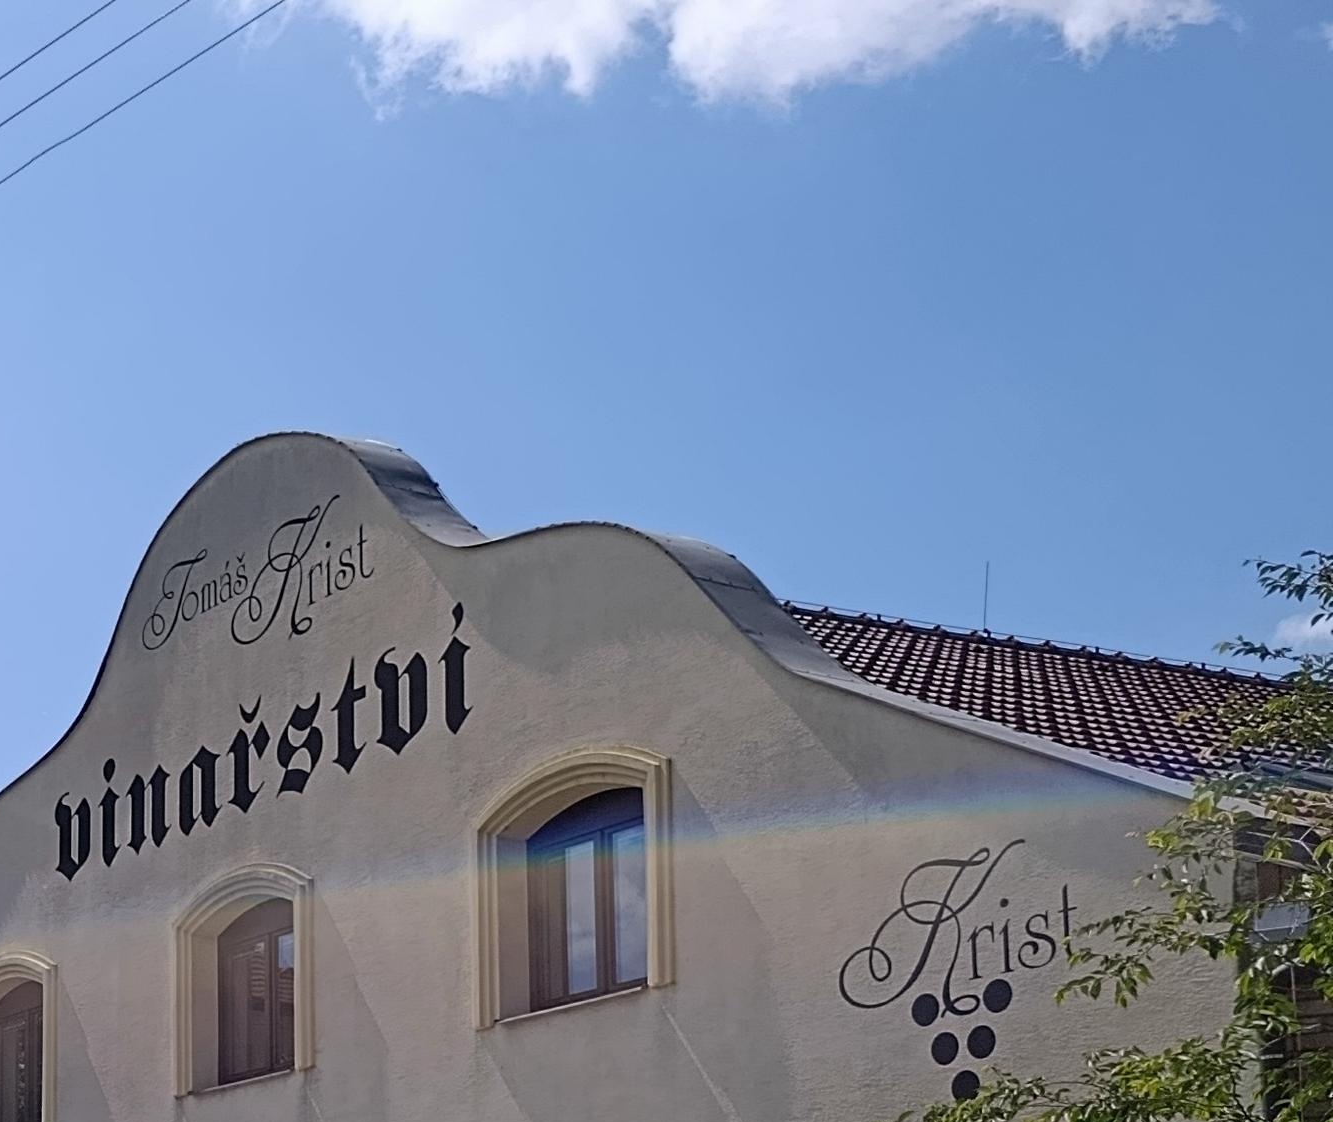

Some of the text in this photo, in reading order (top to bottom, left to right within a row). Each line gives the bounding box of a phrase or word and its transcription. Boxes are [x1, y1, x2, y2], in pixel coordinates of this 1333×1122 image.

[142, 494, 375, 650] Tomáš Krist
[53, 601, 474, 882] vinařství
[838, 838, 1078, 1018] Krist
